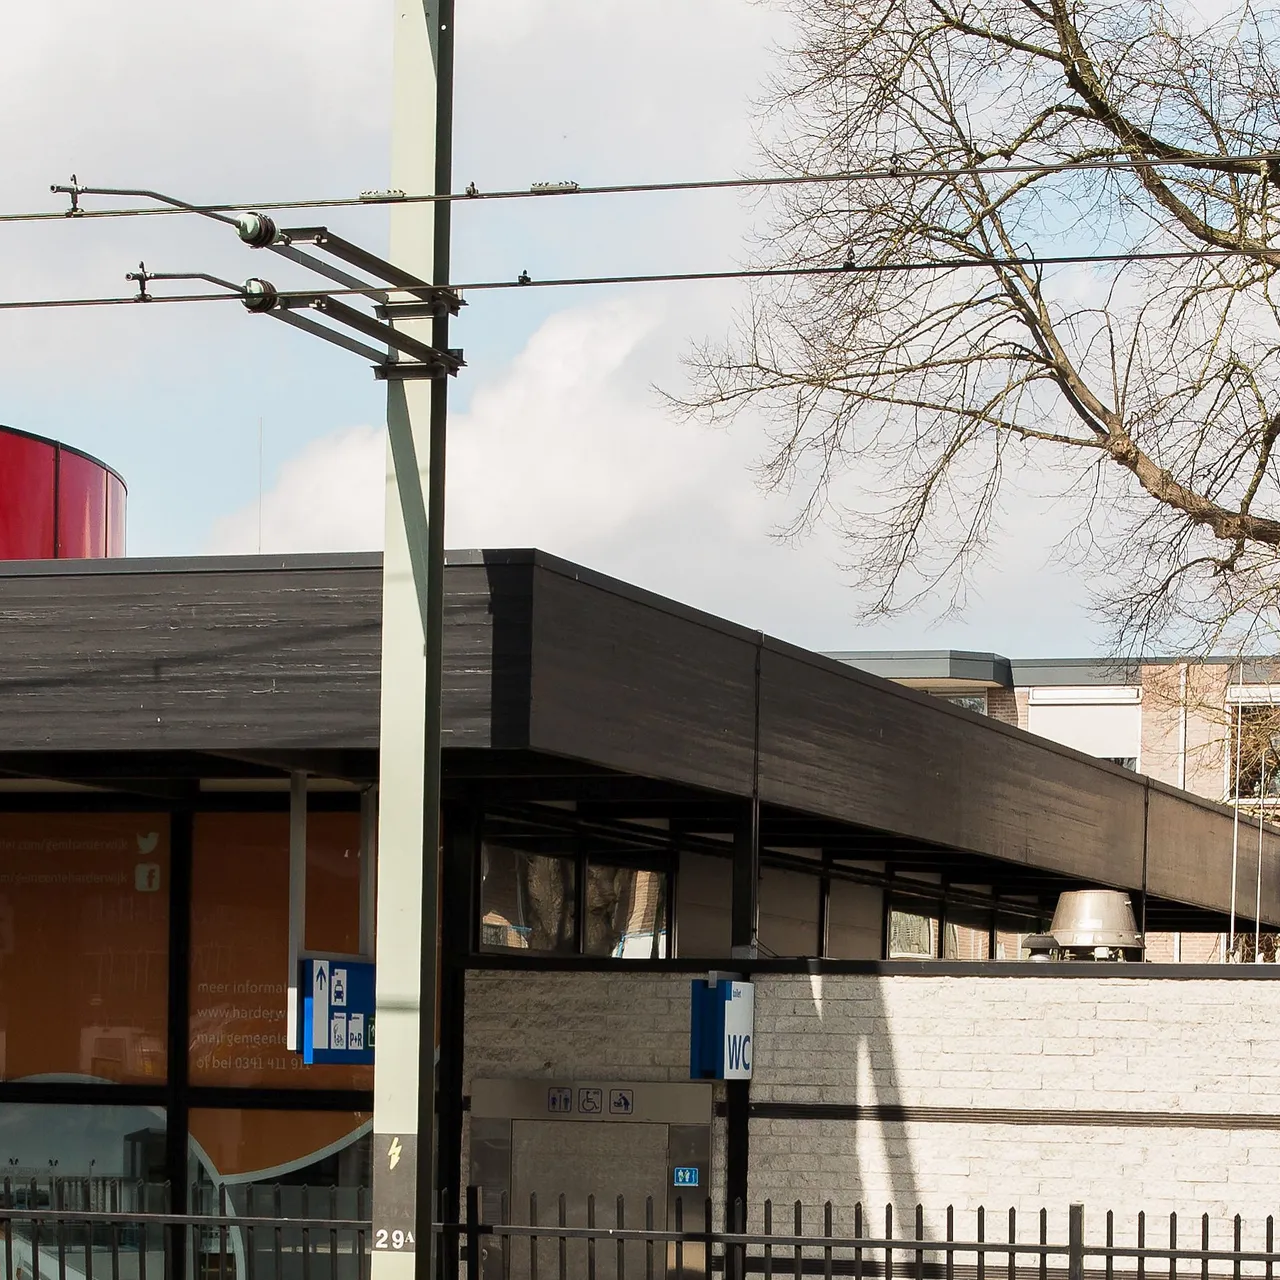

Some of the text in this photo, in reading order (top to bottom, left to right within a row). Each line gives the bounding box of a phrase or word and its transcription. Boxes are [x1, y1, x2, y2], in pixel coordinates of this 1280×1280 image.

[197, 983, 228, 993] meer
[197, 1005, 286, 1019] www.harderw
[197, 1031, 223, 1043] mail
[350, 1033, 363, 1047] P+R
[728, 1034, 751, 1070] WC
[212, 1056, 231, 1069] bel
[235, 1058, 264, 1069] 0341
[267, 1058, 286, 1070] 411
[375, 1229, 415, 1249] 29A
